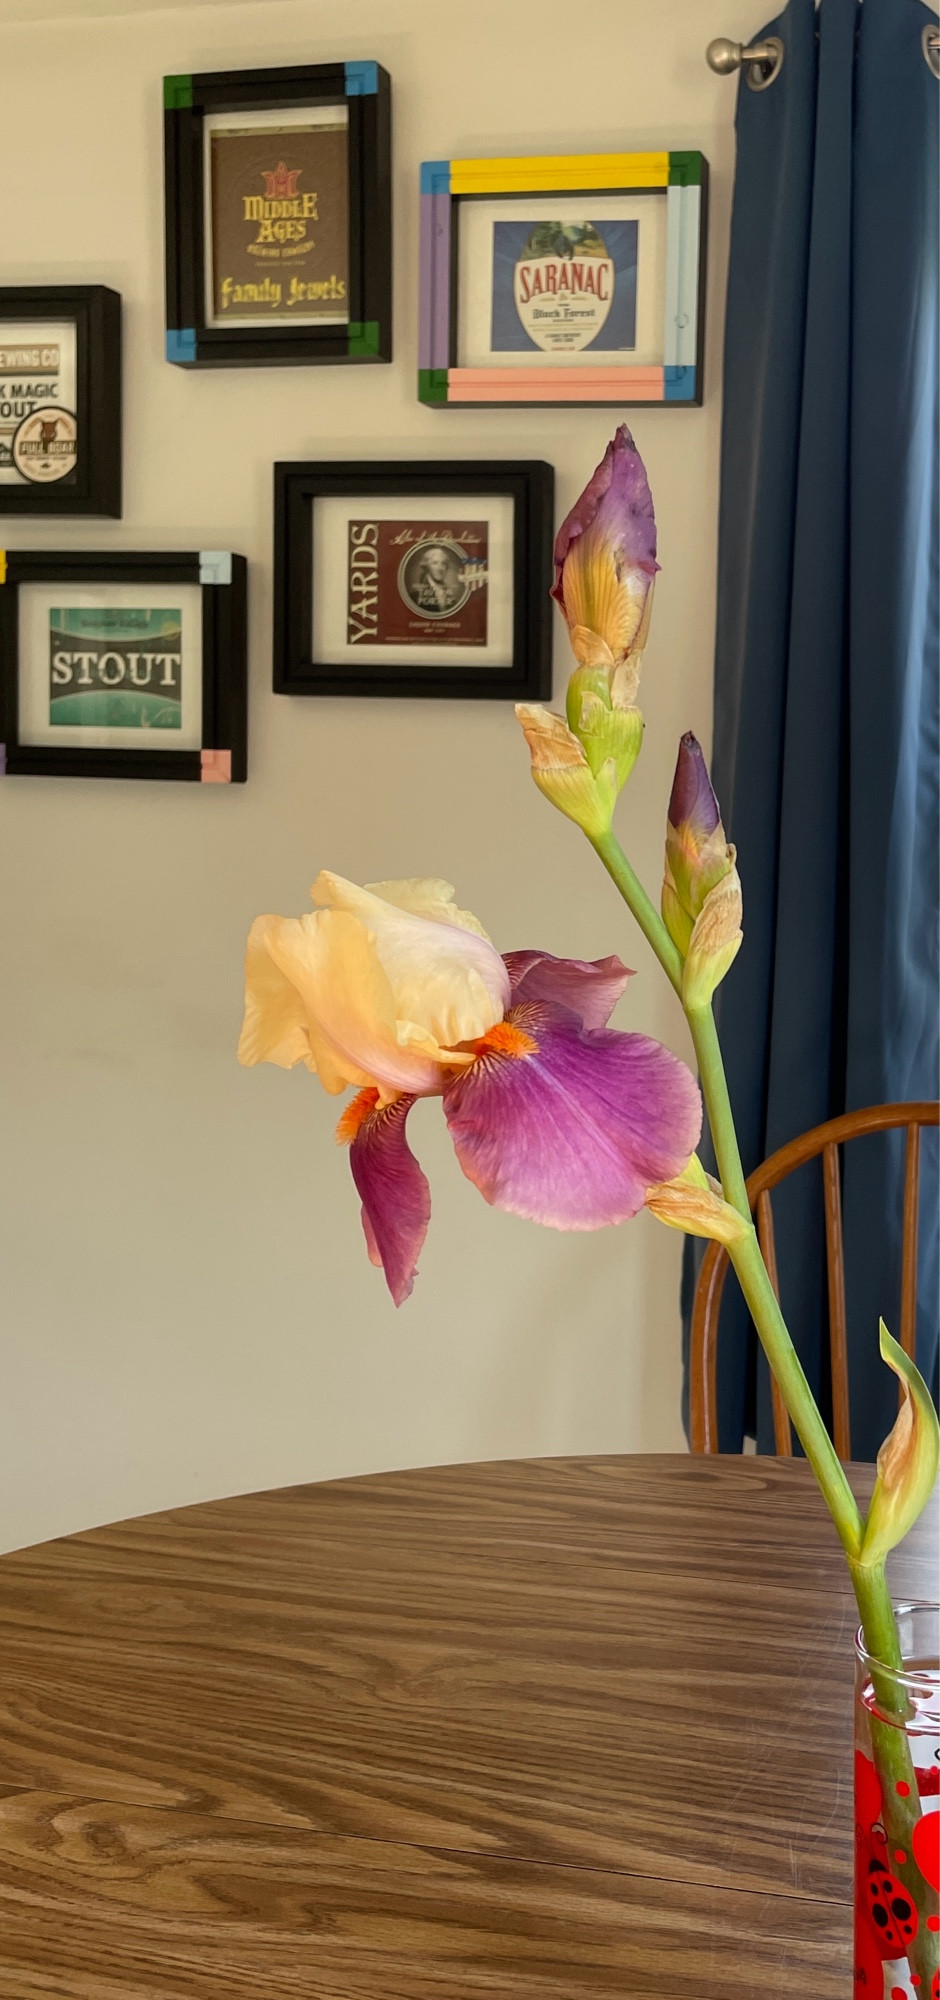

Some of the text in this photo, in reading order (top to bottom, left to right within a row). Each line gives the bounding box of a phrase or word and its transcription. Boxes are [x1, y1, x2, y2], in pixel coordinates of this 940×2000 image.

[242, 193, 319, 221] MIDDLE
[255, 219, 307, 244] AGES
[221, 274, 347, 309] Family Jewels
[519, 262, 609, 304] SARANAC
[532, 308, 596, 319] Black Forest
[10, 383, 59, 398] MAGIC
[349, 523, 379, 643] YARDS
[52, 651, 181, 686] STOUT
